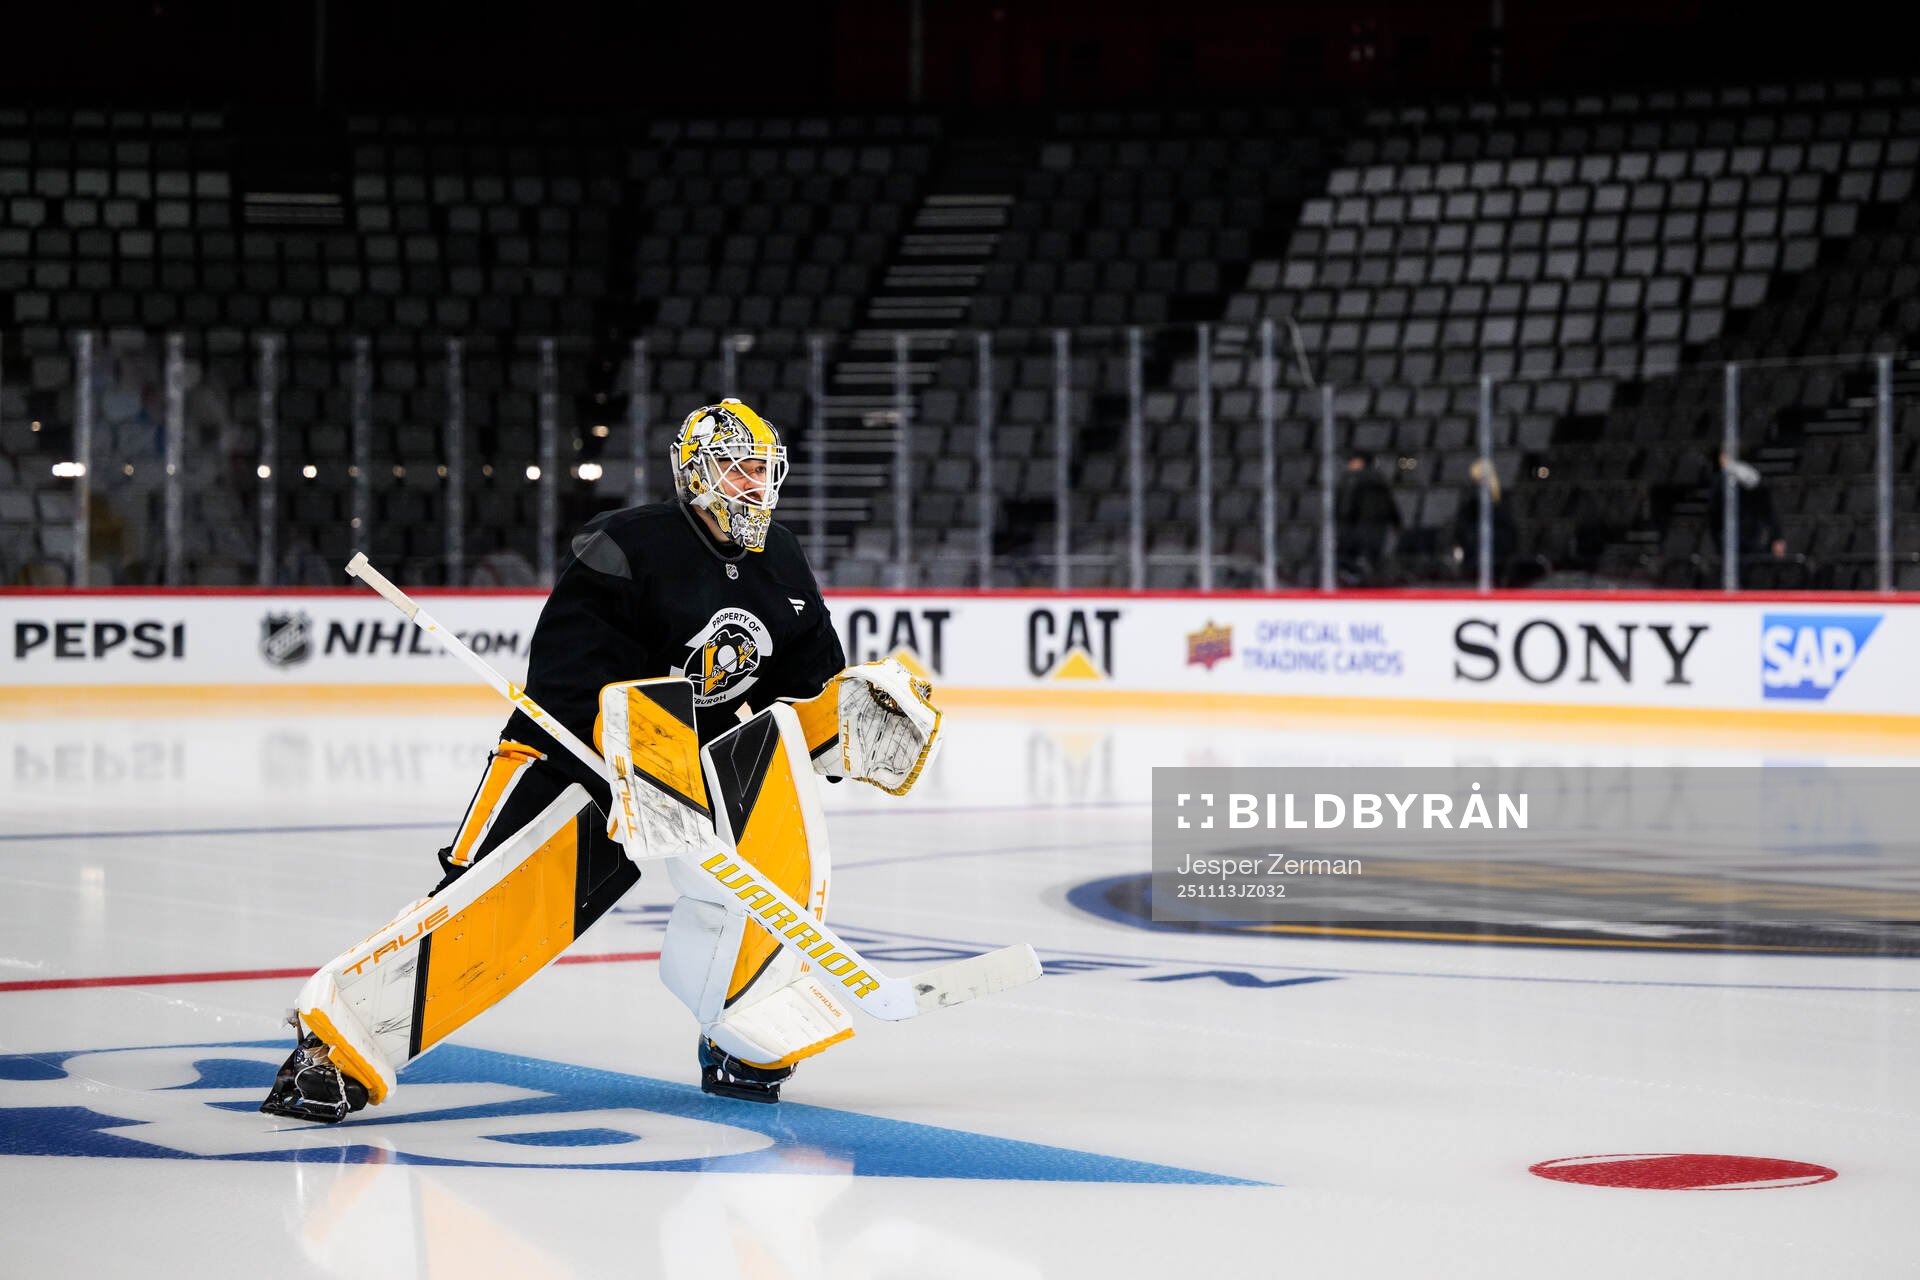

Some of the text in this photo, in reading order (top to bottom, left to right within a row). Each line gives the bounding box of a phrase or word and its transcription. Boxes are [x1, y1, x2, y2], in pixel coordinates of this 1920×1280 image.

[14, 622, 185, 659] PEPSI
[712, 612, 761, 633] PROPERTY OF
[848, 609, 950, 677] CAT
[1028, 609, 1119, 677] CAT
[1256, 621, 1387, 645] OFFICIAL NHL
[1454, 618, 1709, 685] SONY
[1244, 648, 1325, 672] TRADING
[1334, 650, 1404, 676] CARDS
[1762, 626, 1856, 688] SAP
[342, 905, 449, 975] TRUE
[700, 853, 881, 999] WARRIOR
